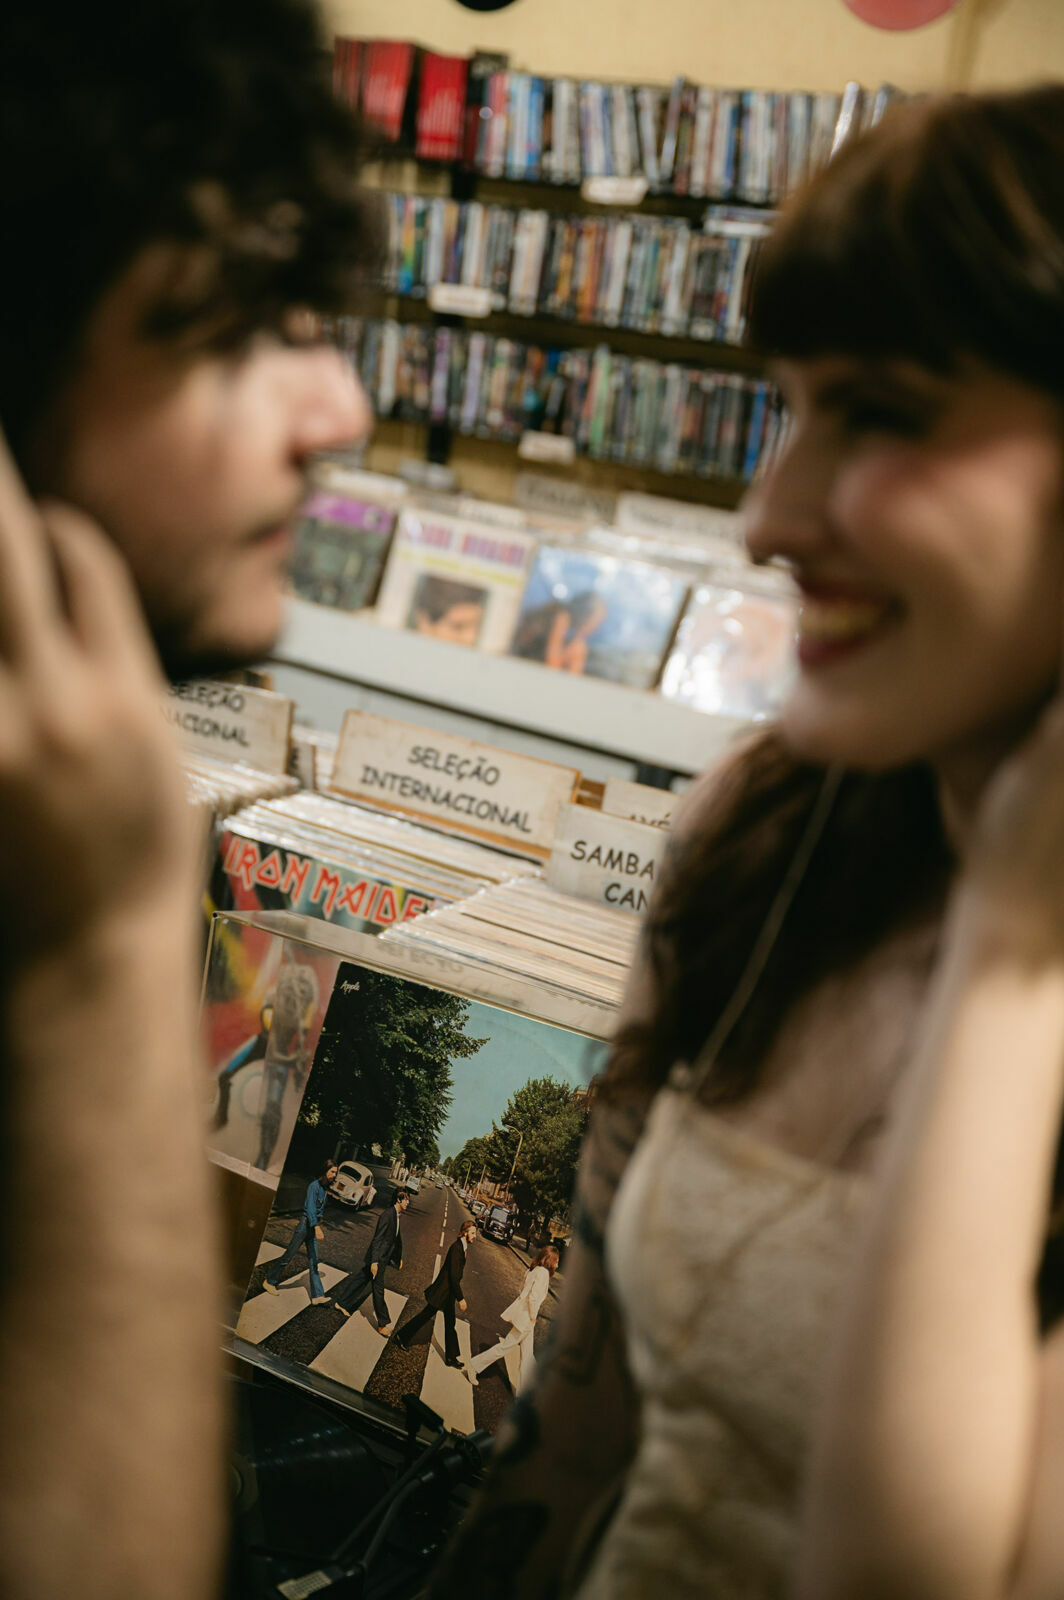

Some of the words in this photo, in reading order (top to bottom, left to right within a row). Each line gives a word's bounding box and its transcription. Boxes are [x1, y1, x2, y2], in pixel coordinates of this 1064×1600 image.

[408, 746, 500, 786] SELEÇÃO
[360, 764, 532, 834] INTERNACIONAL
[570, 840, 655, 880] SAMBA
[223, 836, 311, 908] IRON
[312, 865, 441, 926] MAIDE
[340, 979, 361, 995] Apple
